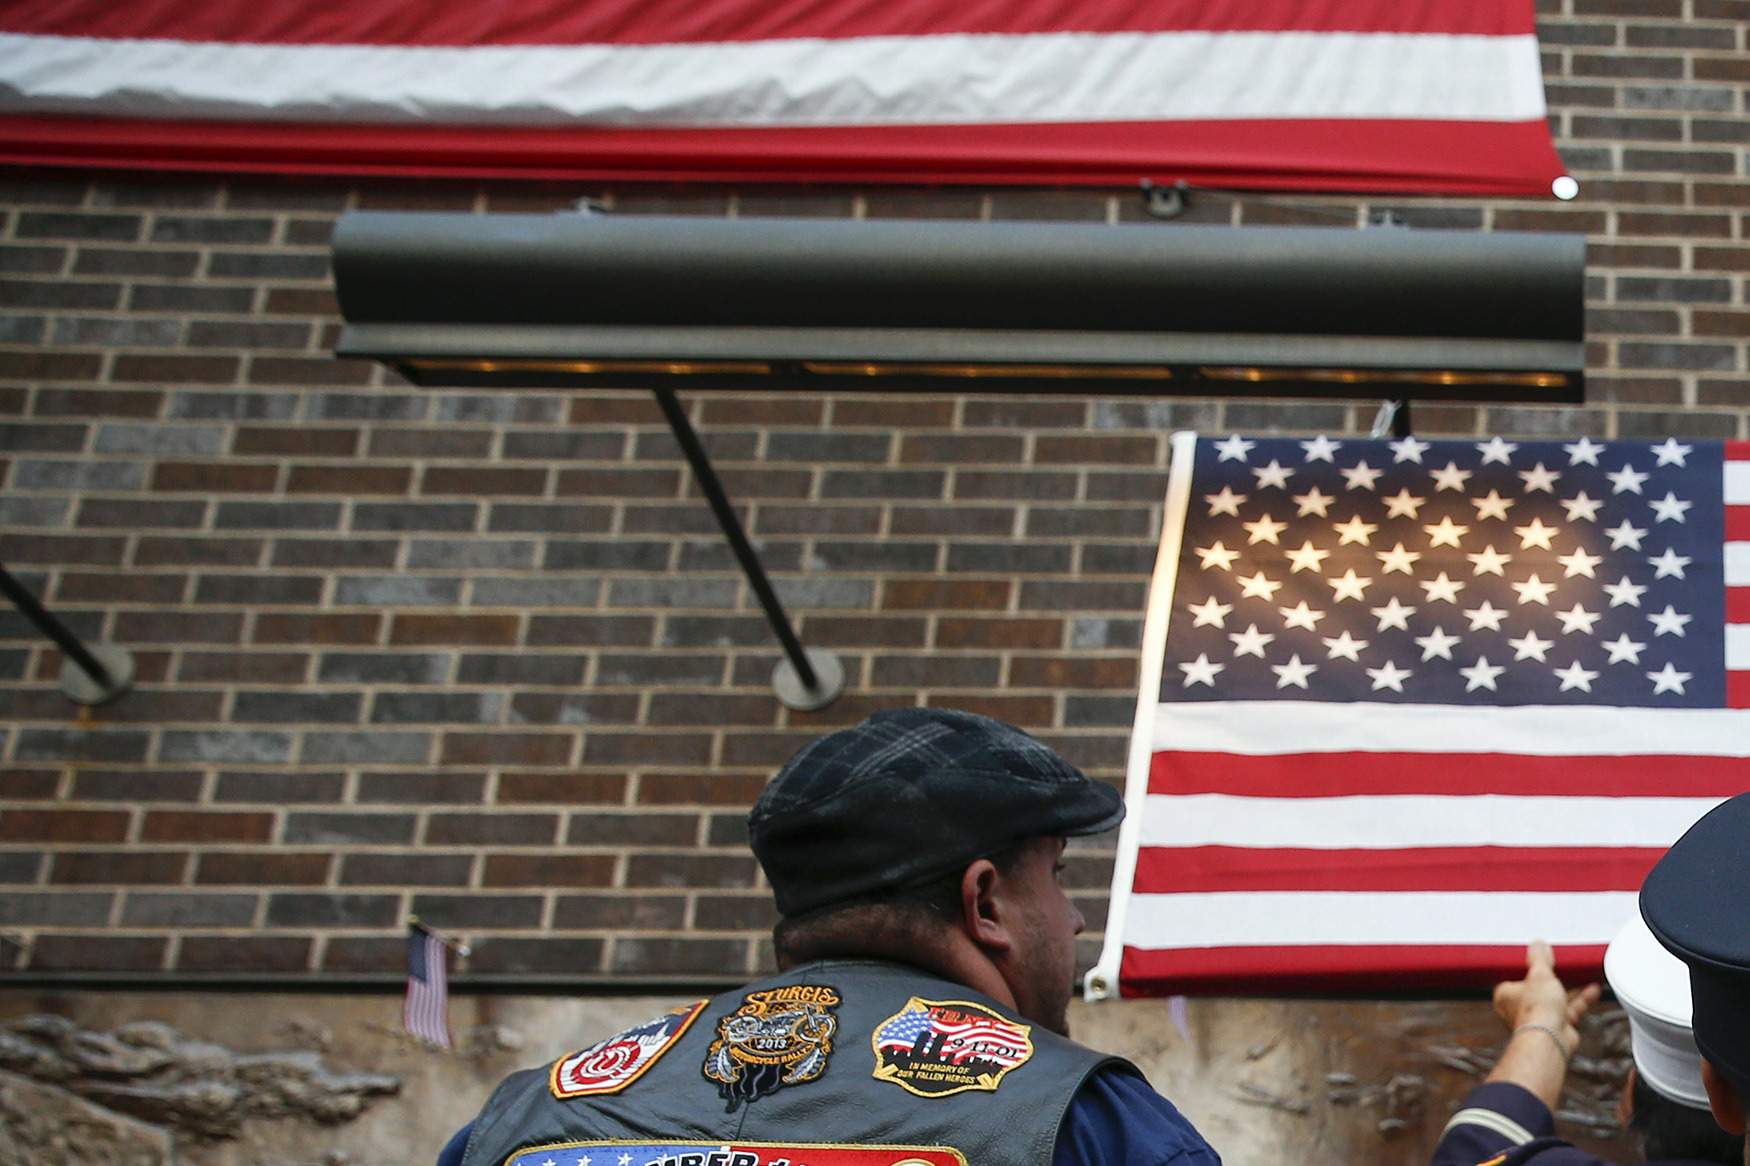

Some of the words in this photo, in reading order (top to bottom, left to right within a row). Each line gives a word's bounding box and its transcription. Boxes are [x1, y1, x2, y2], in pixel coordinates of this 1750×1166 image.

[737, 986, 839, 1016] STURGIS
[757, 1038, 787, 1049] 2013
[950, 1037, 1019, 1059] 9-11-01
[781, 1047, 808, 1063] RALLY
[909, 1062, 917, 1070] IN
[918, 1062, 957, 1073] MEMORY
[958, 1066, 970, 1075] OF
[897, 1070, 914, 1079] OUR
[916, 1071, 943, 1081] FALLEN
[945, 1074, 976, 1085] HEROES
